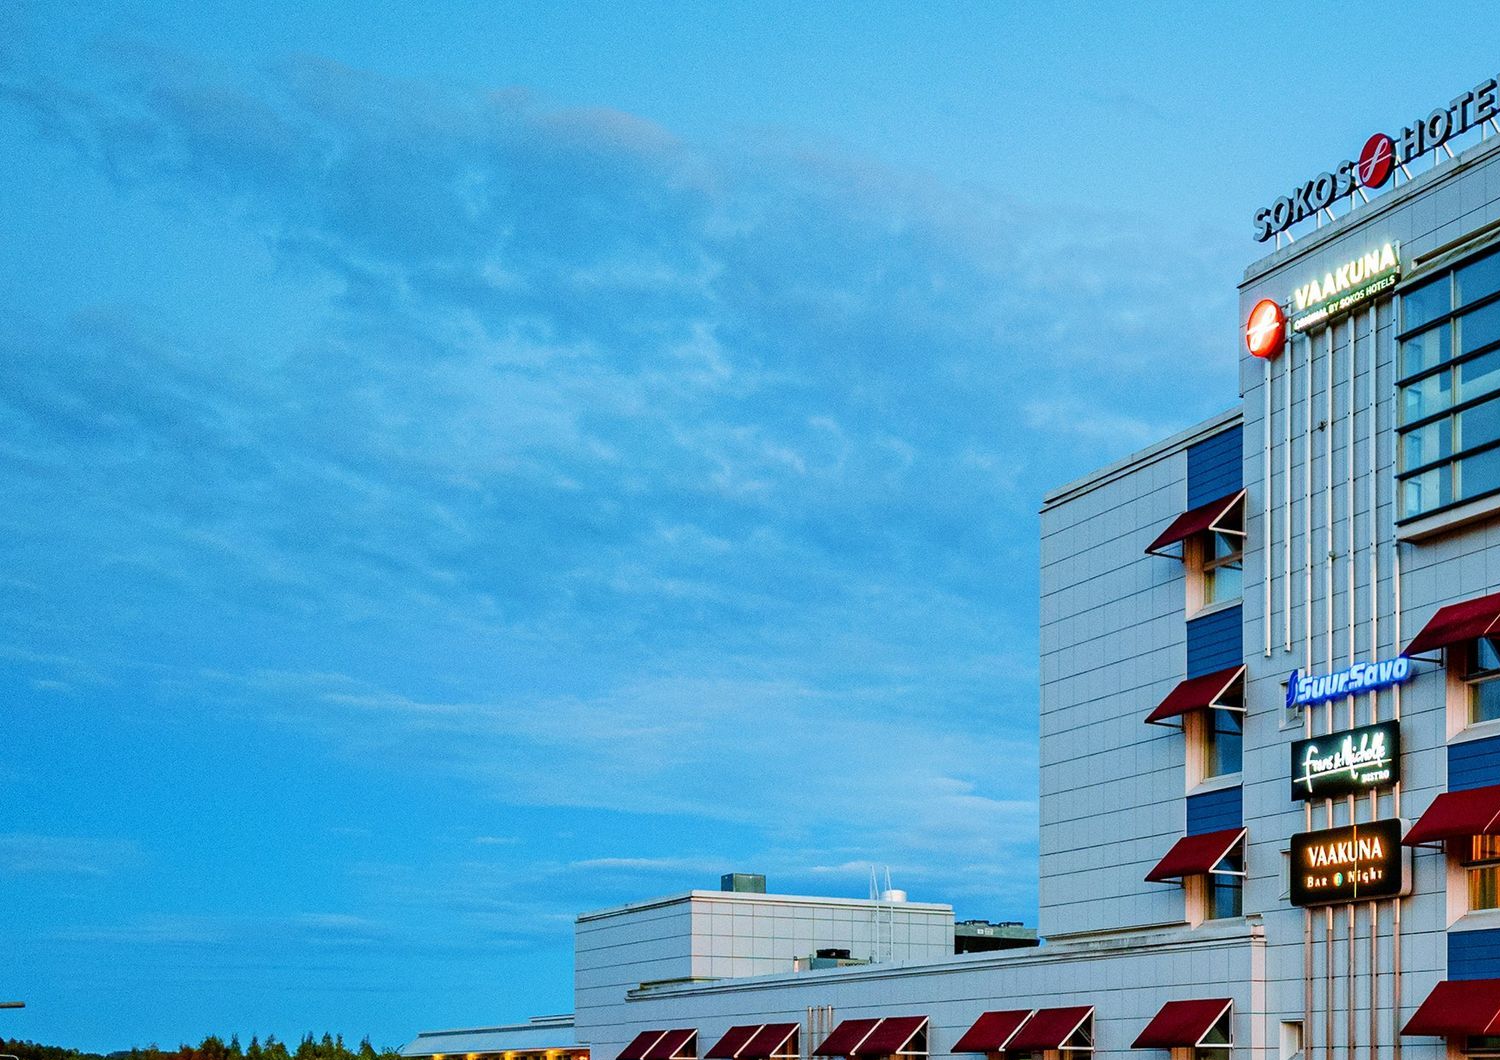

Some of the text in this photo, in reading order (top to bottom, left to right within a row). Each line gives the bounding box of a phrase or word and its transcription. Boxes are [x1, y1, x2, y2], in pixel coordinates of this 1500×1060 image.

[1253, 159, 1356, 242] SOKOS
[1295, 243, 1396, 310] VAAKUNA
[1328, 302, 1339, 314] BY
[1339, 290, 1364, 309] SOKOS
[1366, 275, 1395, 296] HOTELS
[1308, 836, 1383, 868] VAAKUNA
